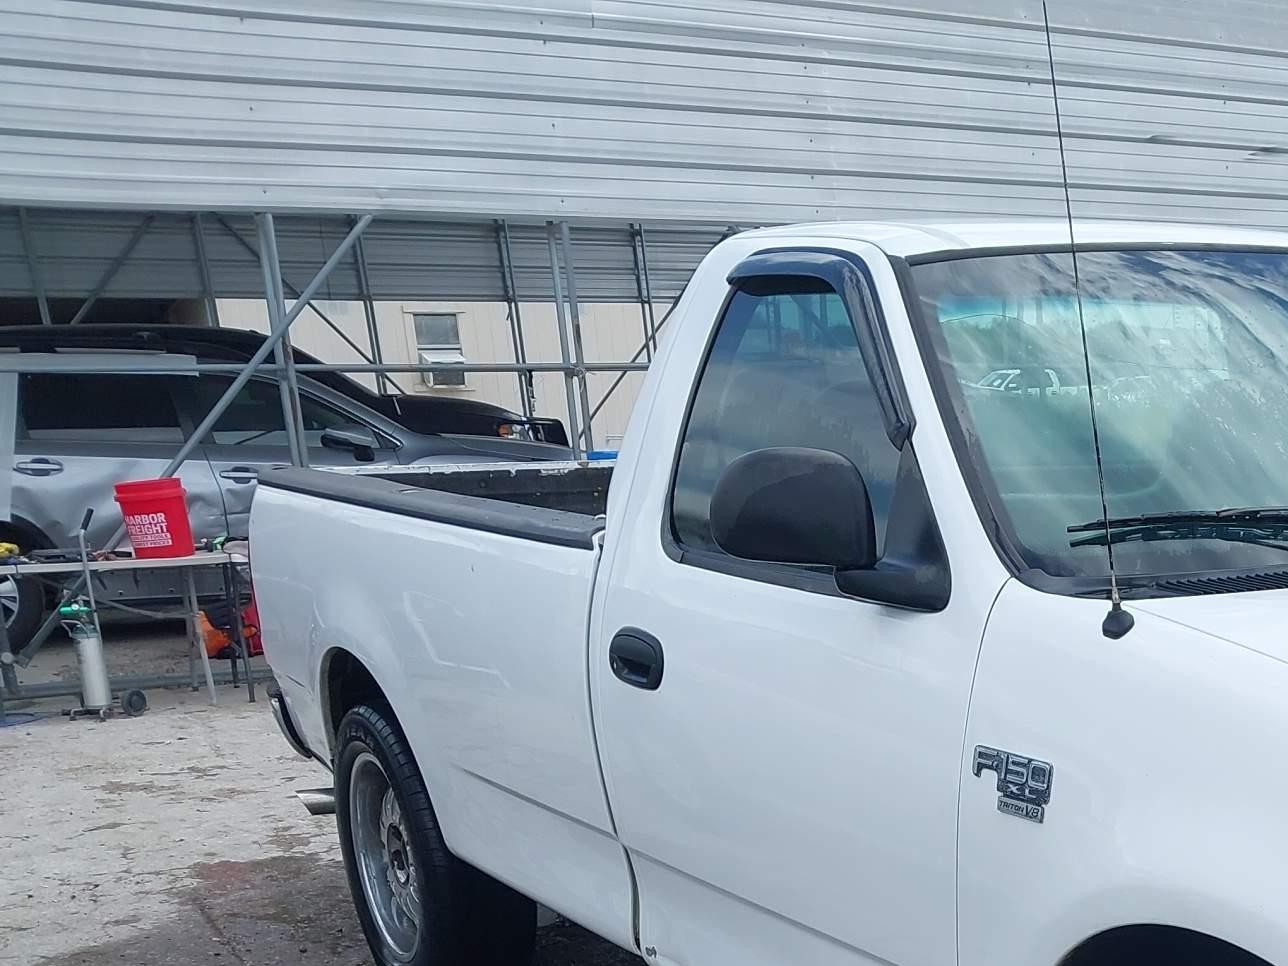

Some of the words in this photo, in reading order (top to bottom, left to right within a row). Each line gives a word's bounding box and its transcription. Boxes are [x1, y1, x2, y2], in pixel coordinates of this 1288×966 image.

[125, 513, 166, 525] HARBOR
[128, 523, 168, 534] FREIGHT
[1007, 784, 1036, 799] XL
[1000, 801, 1025, 813] TRITON
[1025, 804, 1040, 818] V8
